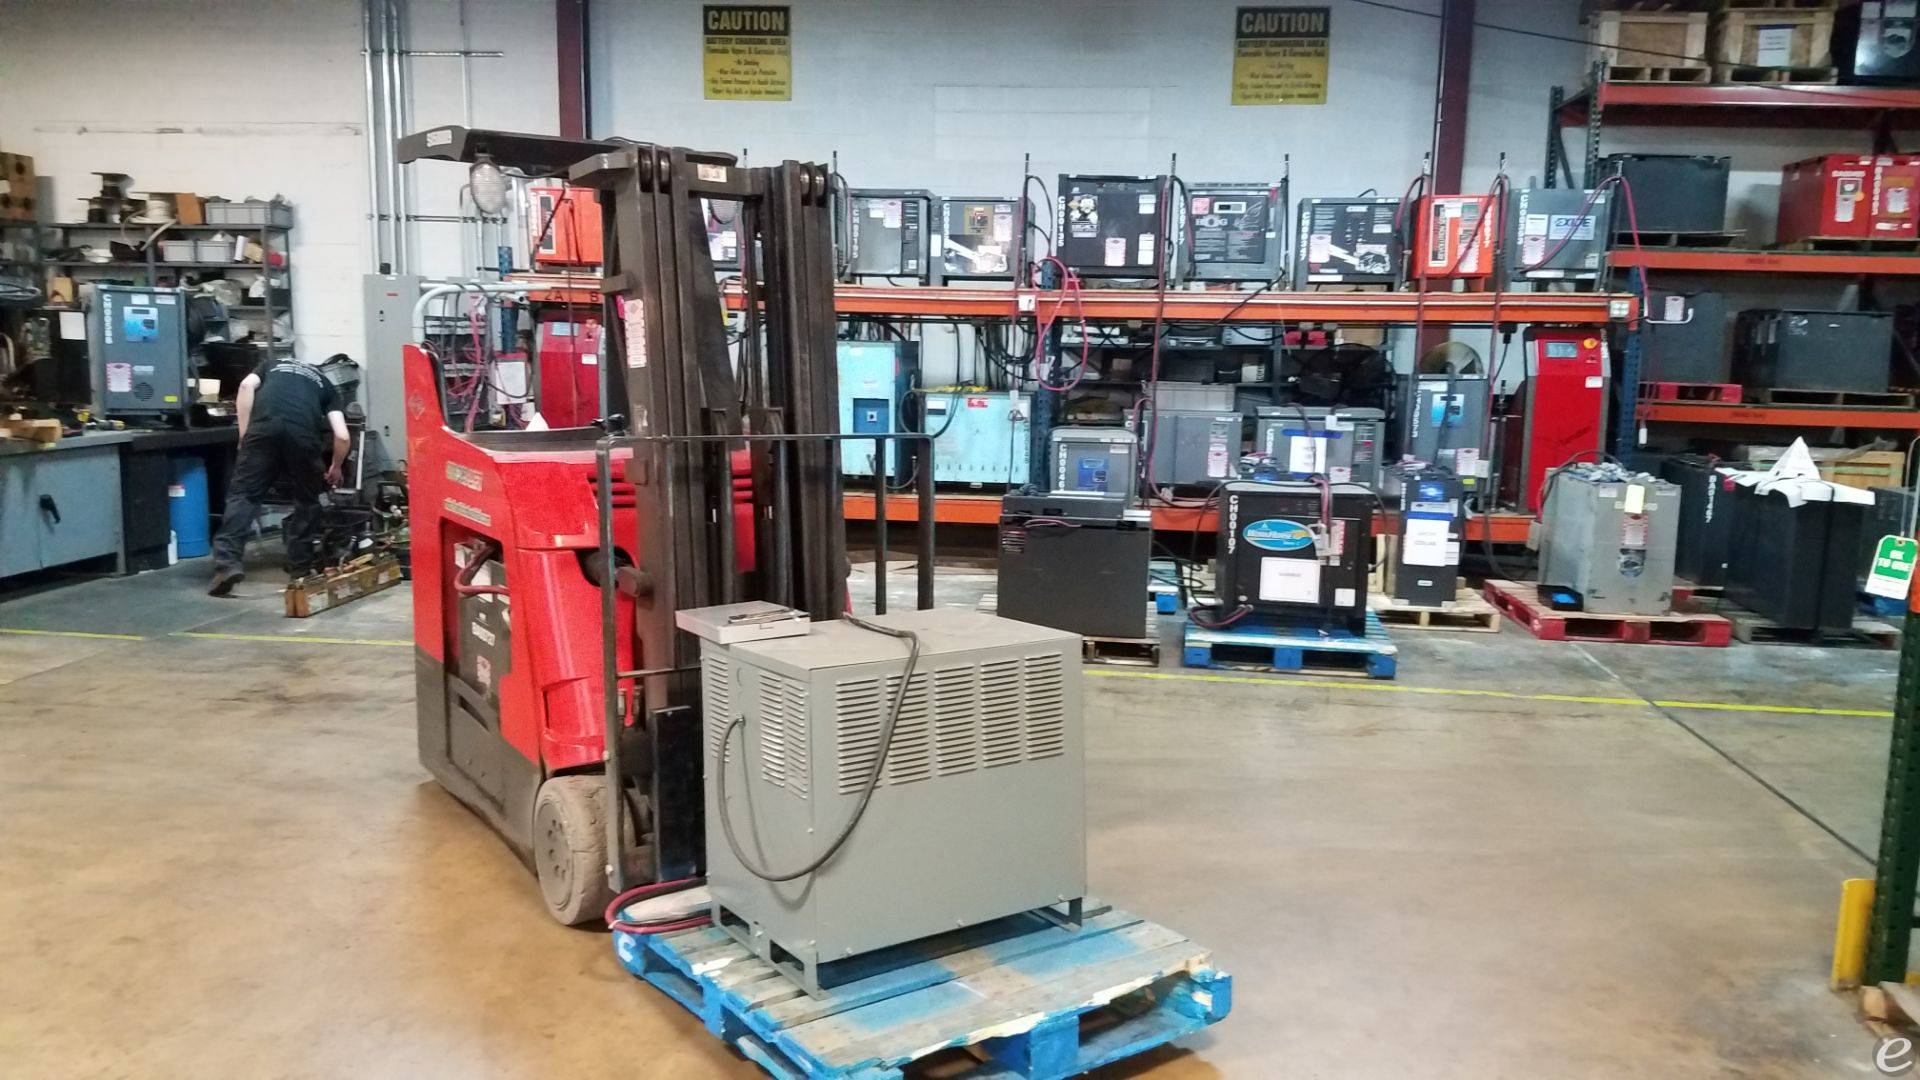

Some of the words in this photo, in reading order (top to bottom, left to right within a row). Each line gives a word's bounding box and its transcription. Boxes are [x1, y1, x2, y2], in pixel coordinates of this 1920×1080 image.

[707, 10, 785, 31] CAUTION
[1240, 12, 1325, 33] CAUTION
[1058, 443, 1068, 491] CH0046
